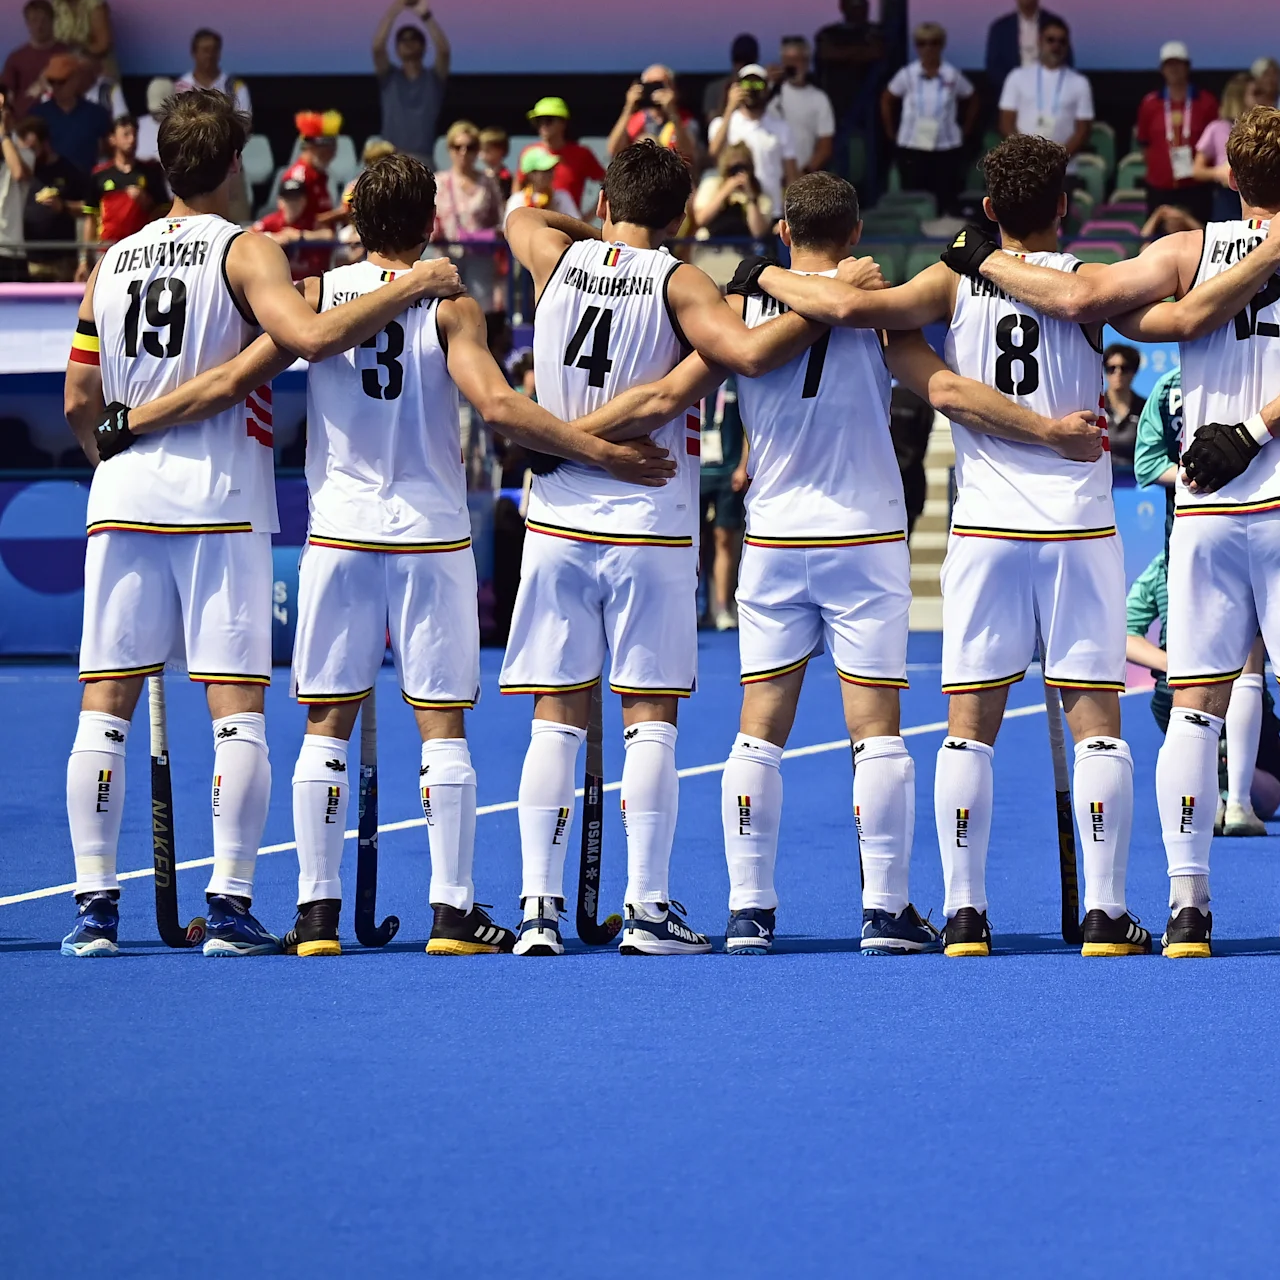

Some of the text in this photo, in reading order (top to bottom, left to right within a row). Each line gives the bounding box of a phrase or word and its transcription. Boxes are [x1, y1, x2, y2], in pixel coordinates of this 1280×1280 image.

[114, 239, 209, 275] DENAYER
[124, 276, 187, 358] 19
[360, 320, 405, 401] 3
[563, 306, 613, 389] 4
[995, 313, 1040, 397] 8
[97, 783, 110, 813] BEL
[325, 797, 338, 824] BEL
[553, 817, 567, 845] BEL
[740, 808, 751, 836] BEL
[958, 820, 969, 848] BEL
[1091, 814, 1104, 842] BEL
[1180, 806, 1193, 834] BEL
[153, 799, 171, 889] NAKED
[588, 820, 600, 864] OSAKA
